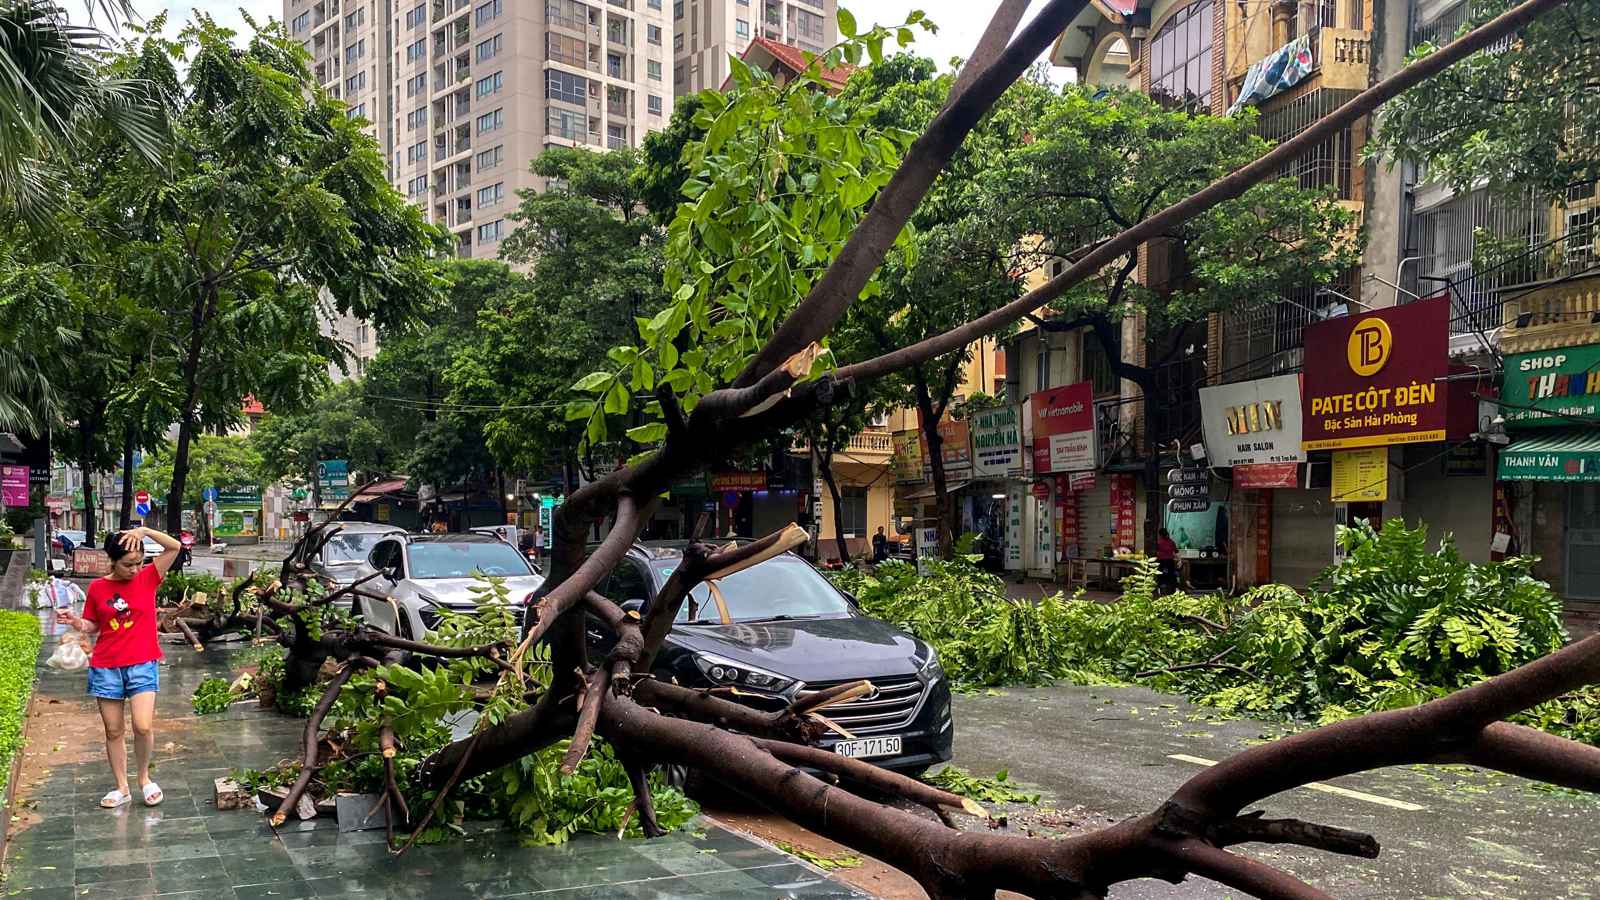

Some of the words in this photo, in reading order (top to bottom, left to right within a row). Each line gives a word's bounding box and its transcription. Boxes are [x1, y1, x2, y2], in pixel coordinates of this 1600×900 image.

[1519, 355, 1566, 371] SHOP
[1311, 393, 1353, 416] PATE
[1355, 386, 1391, 412] CỘT
[1395, 380, 1435, 406] ĐÈN
[1047, 401, 1084, 417] vietnamobile
[1224, 400, 1281, 436] MIN
[1324, 419, 1342, 432] Đặc
[1344, 416, 1361, 429] Sản
[1364, 414, 1381, 427] Hải
[1383, 411, 1417, 426] Phòng
[1237, 443, 1251, 453] HAIR
[1253, 441, 1274, 451] SALON
[1505, 456, 1536, 467] THANH
[1173, 501, 1192, 511] PHUN
